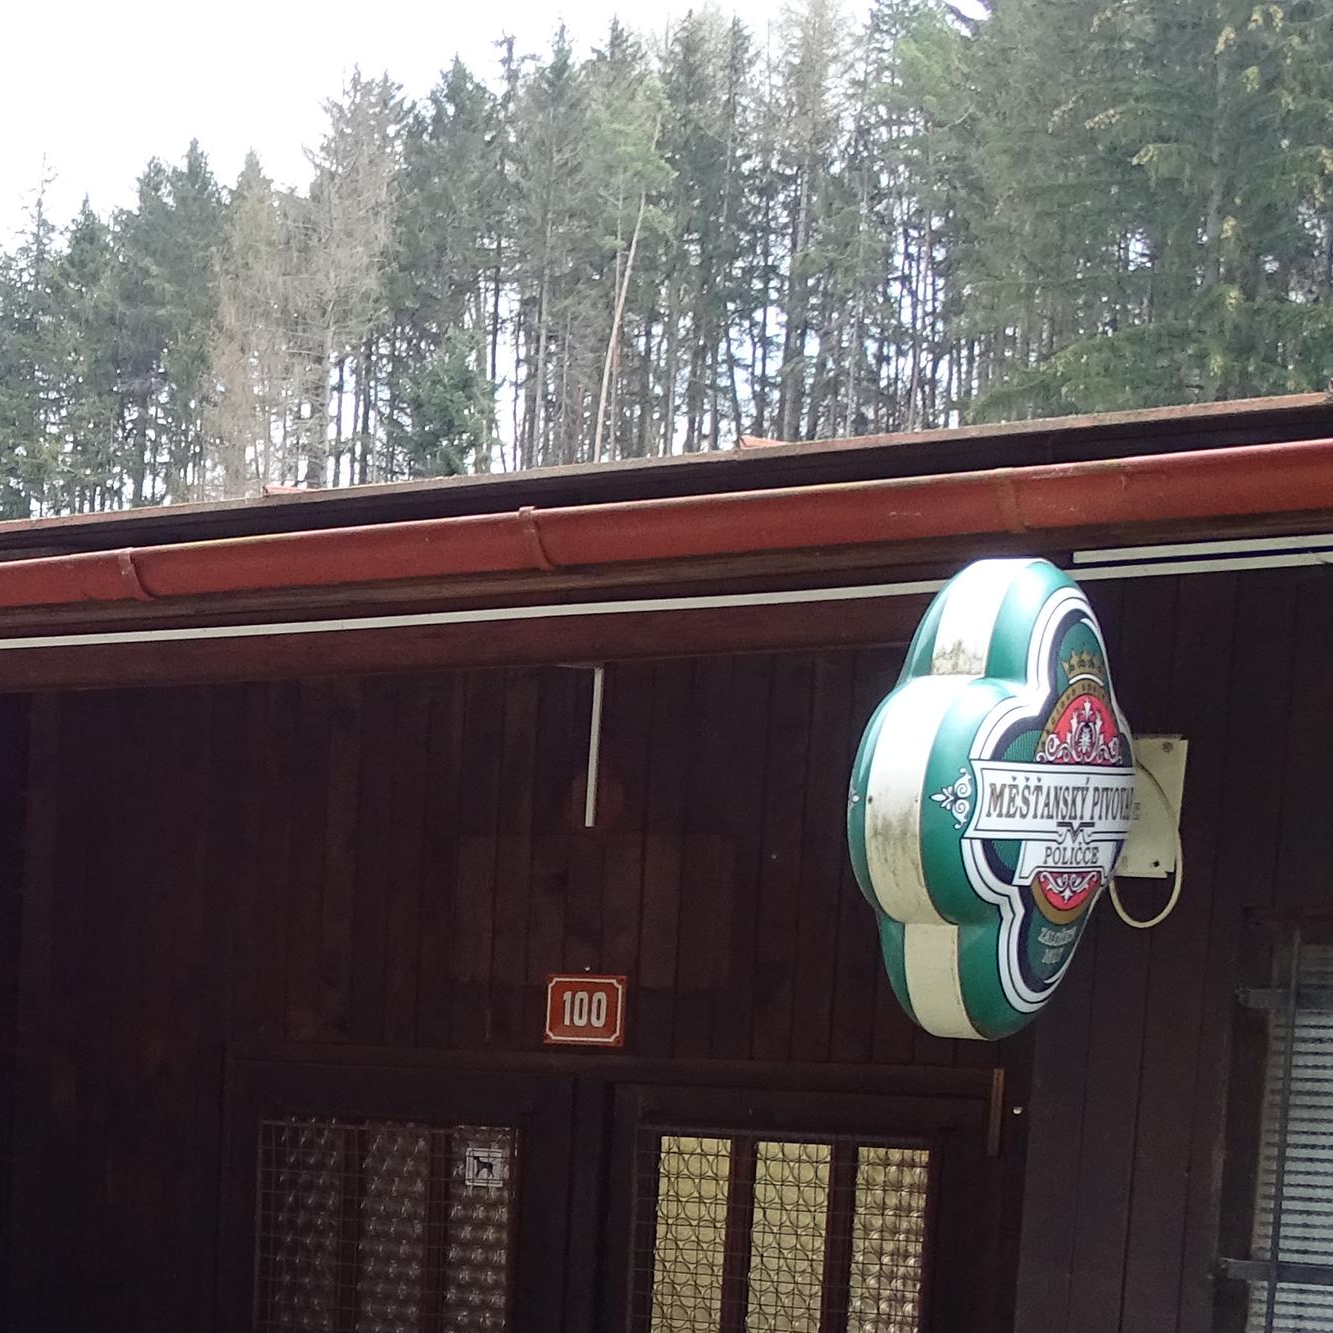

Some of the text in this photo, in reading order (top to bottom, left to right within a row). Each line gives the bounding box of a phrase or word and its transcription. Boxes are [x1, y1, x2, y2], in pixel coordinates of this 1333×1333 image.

[985, 775, 1090, 821] MĚŠŤANSKÝ
[1043, 841, 1099, 866] POLIČCE
[562, 990, 608, 1028] 100
